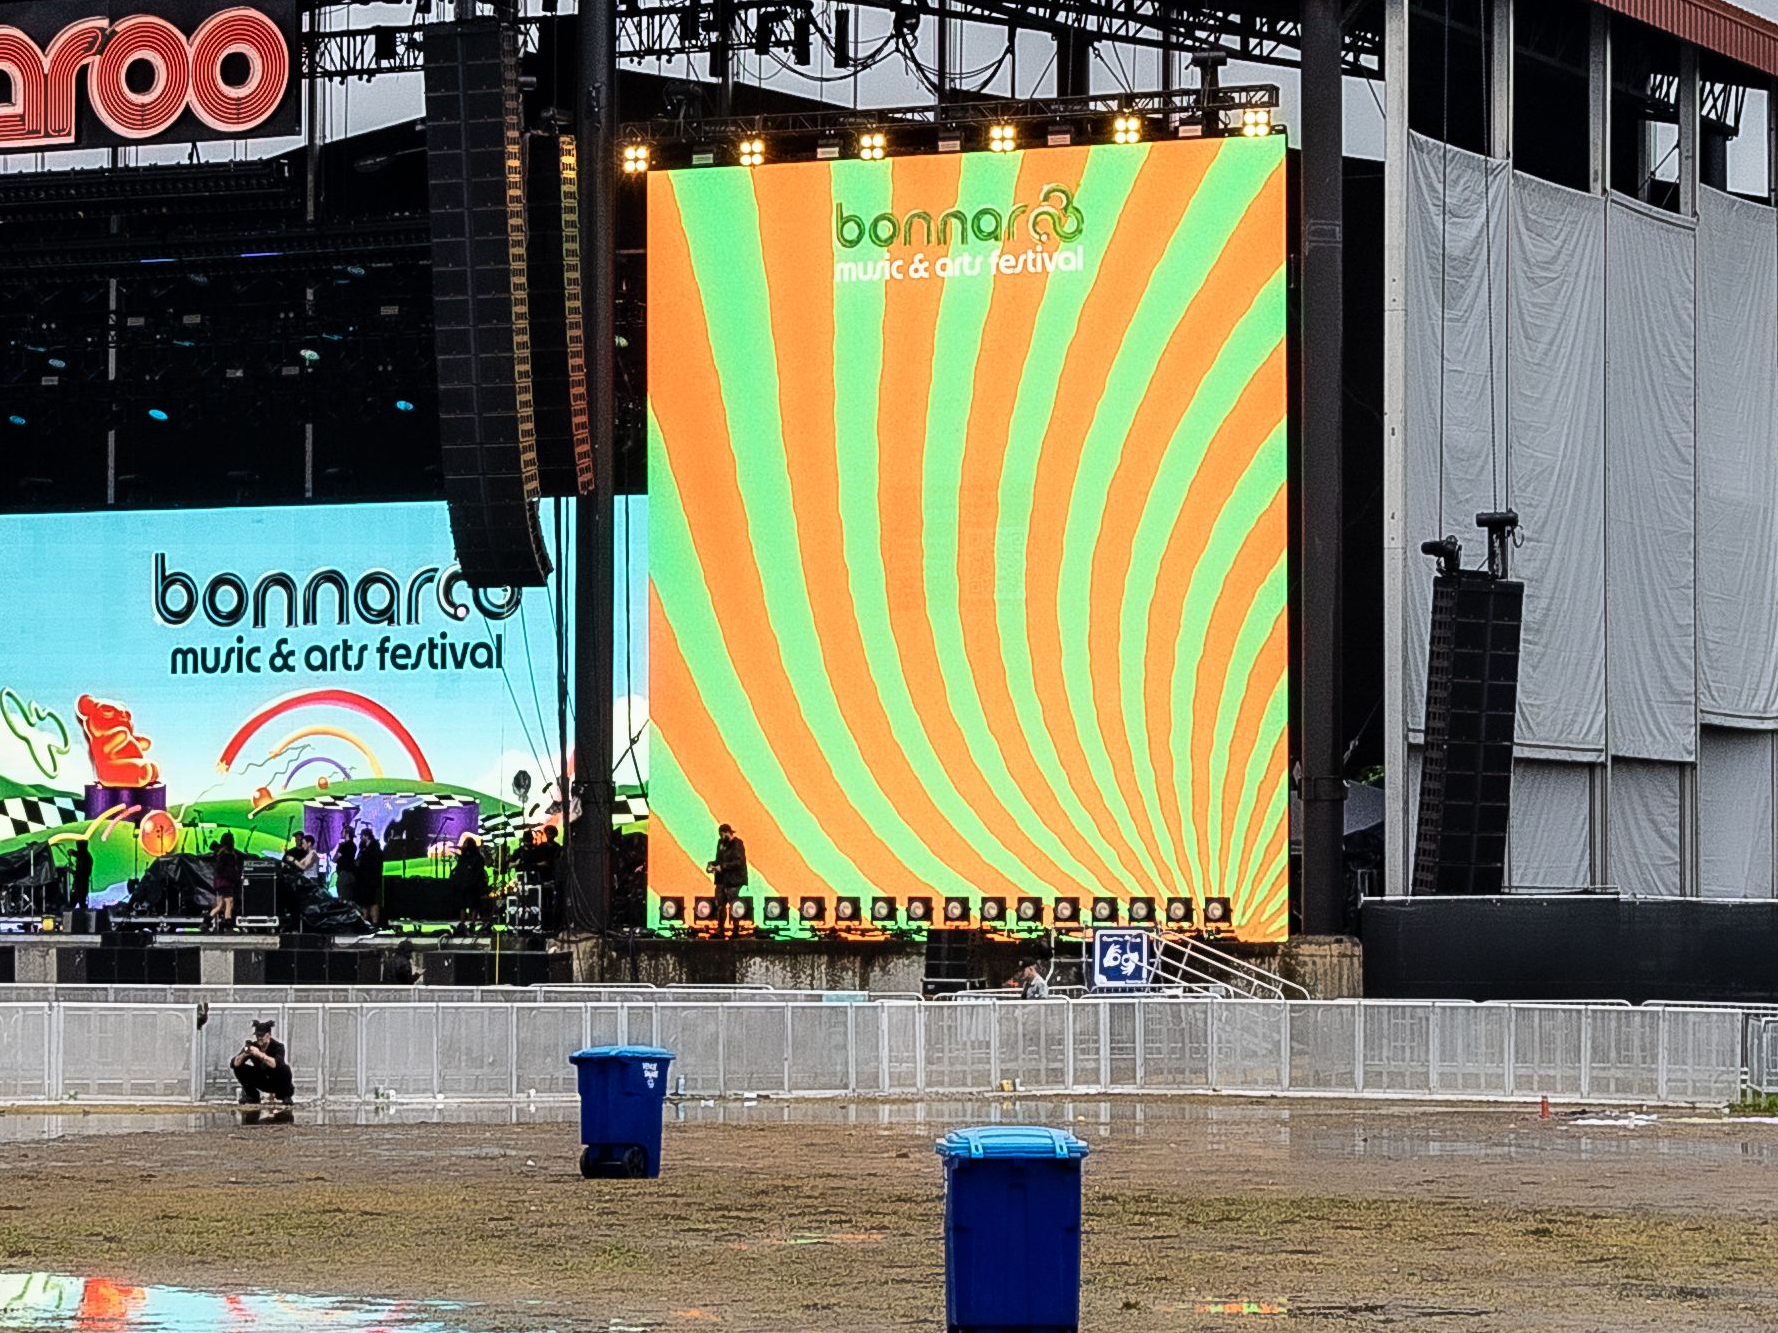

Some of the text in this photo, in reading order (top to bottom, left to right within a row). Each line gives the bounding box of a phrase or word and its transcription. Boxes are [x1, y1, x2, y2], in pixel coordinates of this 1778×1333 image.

[835, 245, 1084, 283] music & arts festival
[171, 631, 503, 674] music & arts festival
